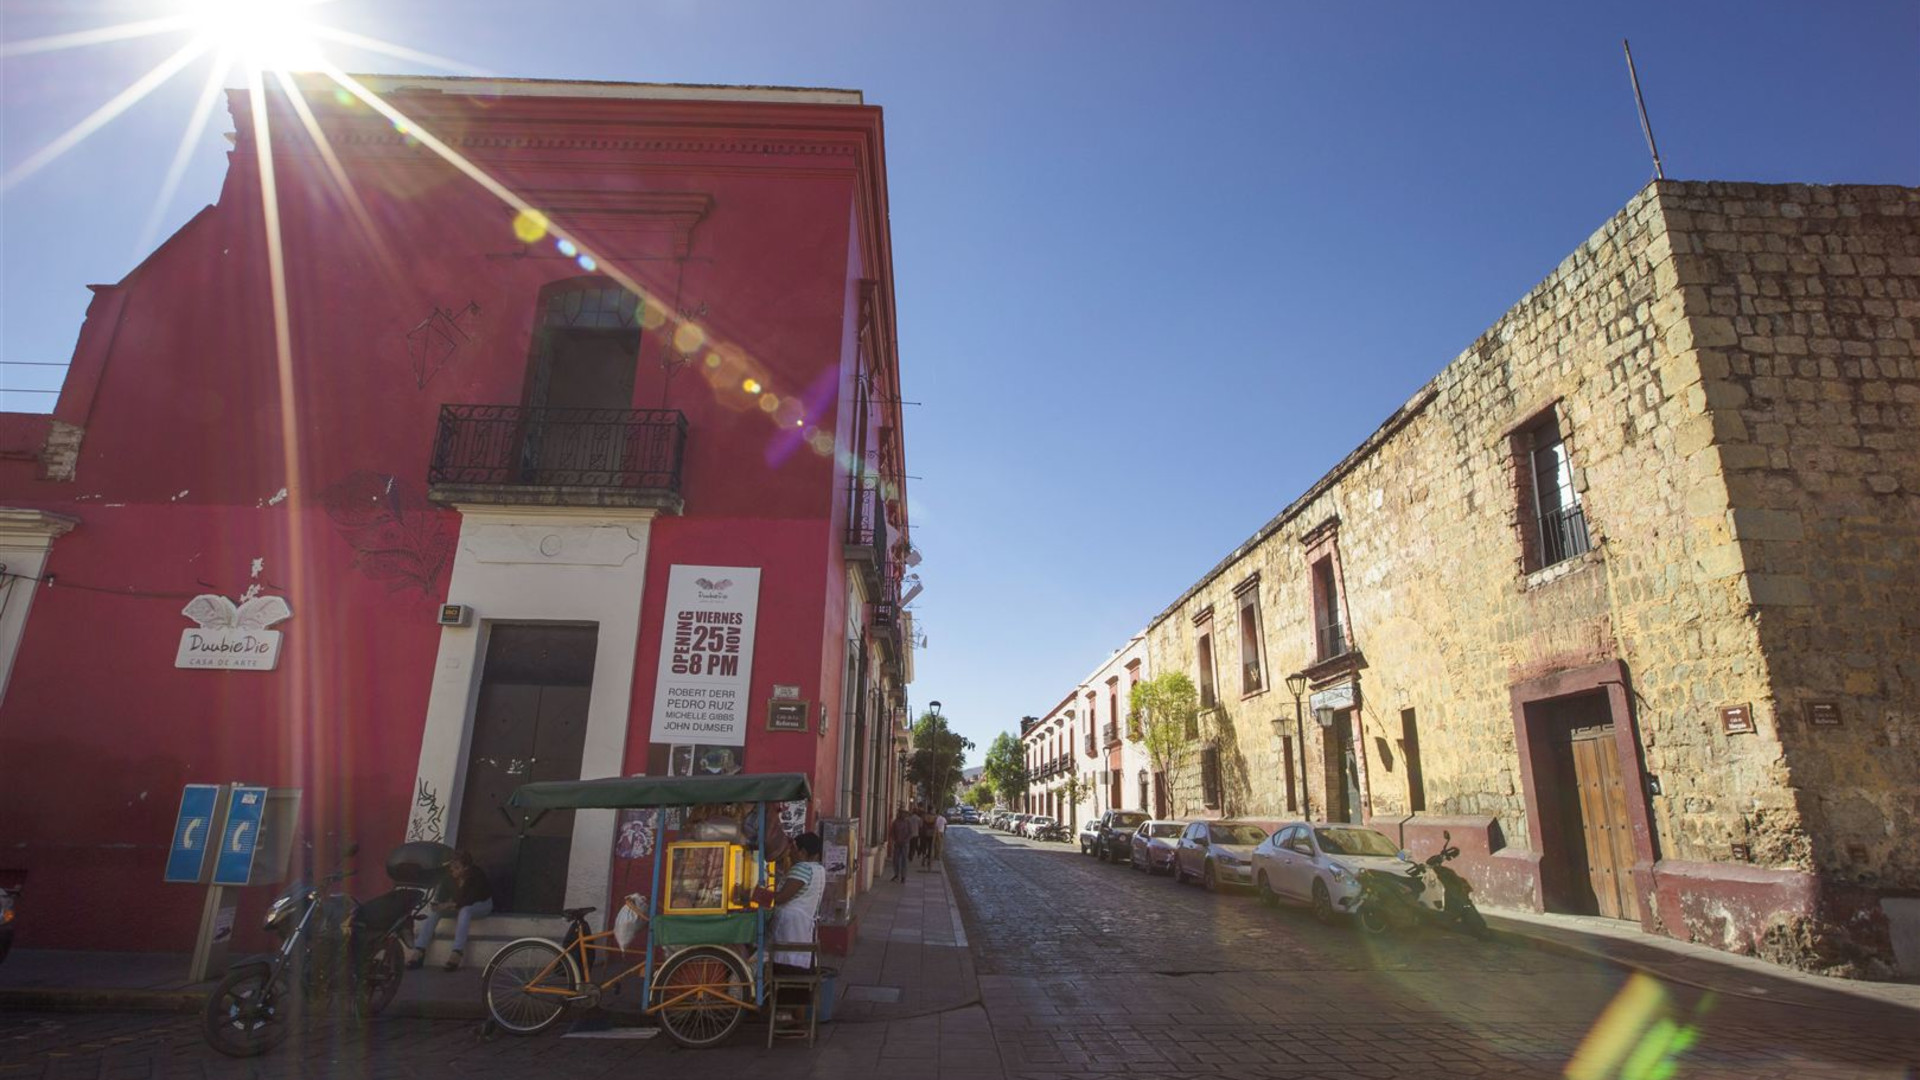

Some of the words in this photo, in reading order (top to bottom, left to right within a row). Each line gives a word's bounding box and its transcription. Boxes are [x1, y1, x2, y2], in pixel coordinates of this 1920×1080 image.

[695, 611, 743, 625] VIERNES
[190, 634, 270, 654] DuubieDie
[671, 611, 694, 674] OPENING
[691, 625, 724, 653] 25
[725, 626, 741, 653] NOV
[189, 658, 214, 666] CASA
[217, 658, 229, 666] DE
[233, 658, 258, 667] ARTE
[688, 653, 703, 675] 8
[706, 654, 739, 676] PM
[668, 688, 707, 698] ROBERT
[708, 689, 736, 699] DERR
[666, 699, 706, 710] PEDRO
[708, 700, 735, 711] RUIZ
[665, 711, 707, 721] MICHELLE
[708, 712, 735, 722] GIBBS
[663, 721, 690, 731] JOHN
[692, 722, 734, 732] DUMSER
